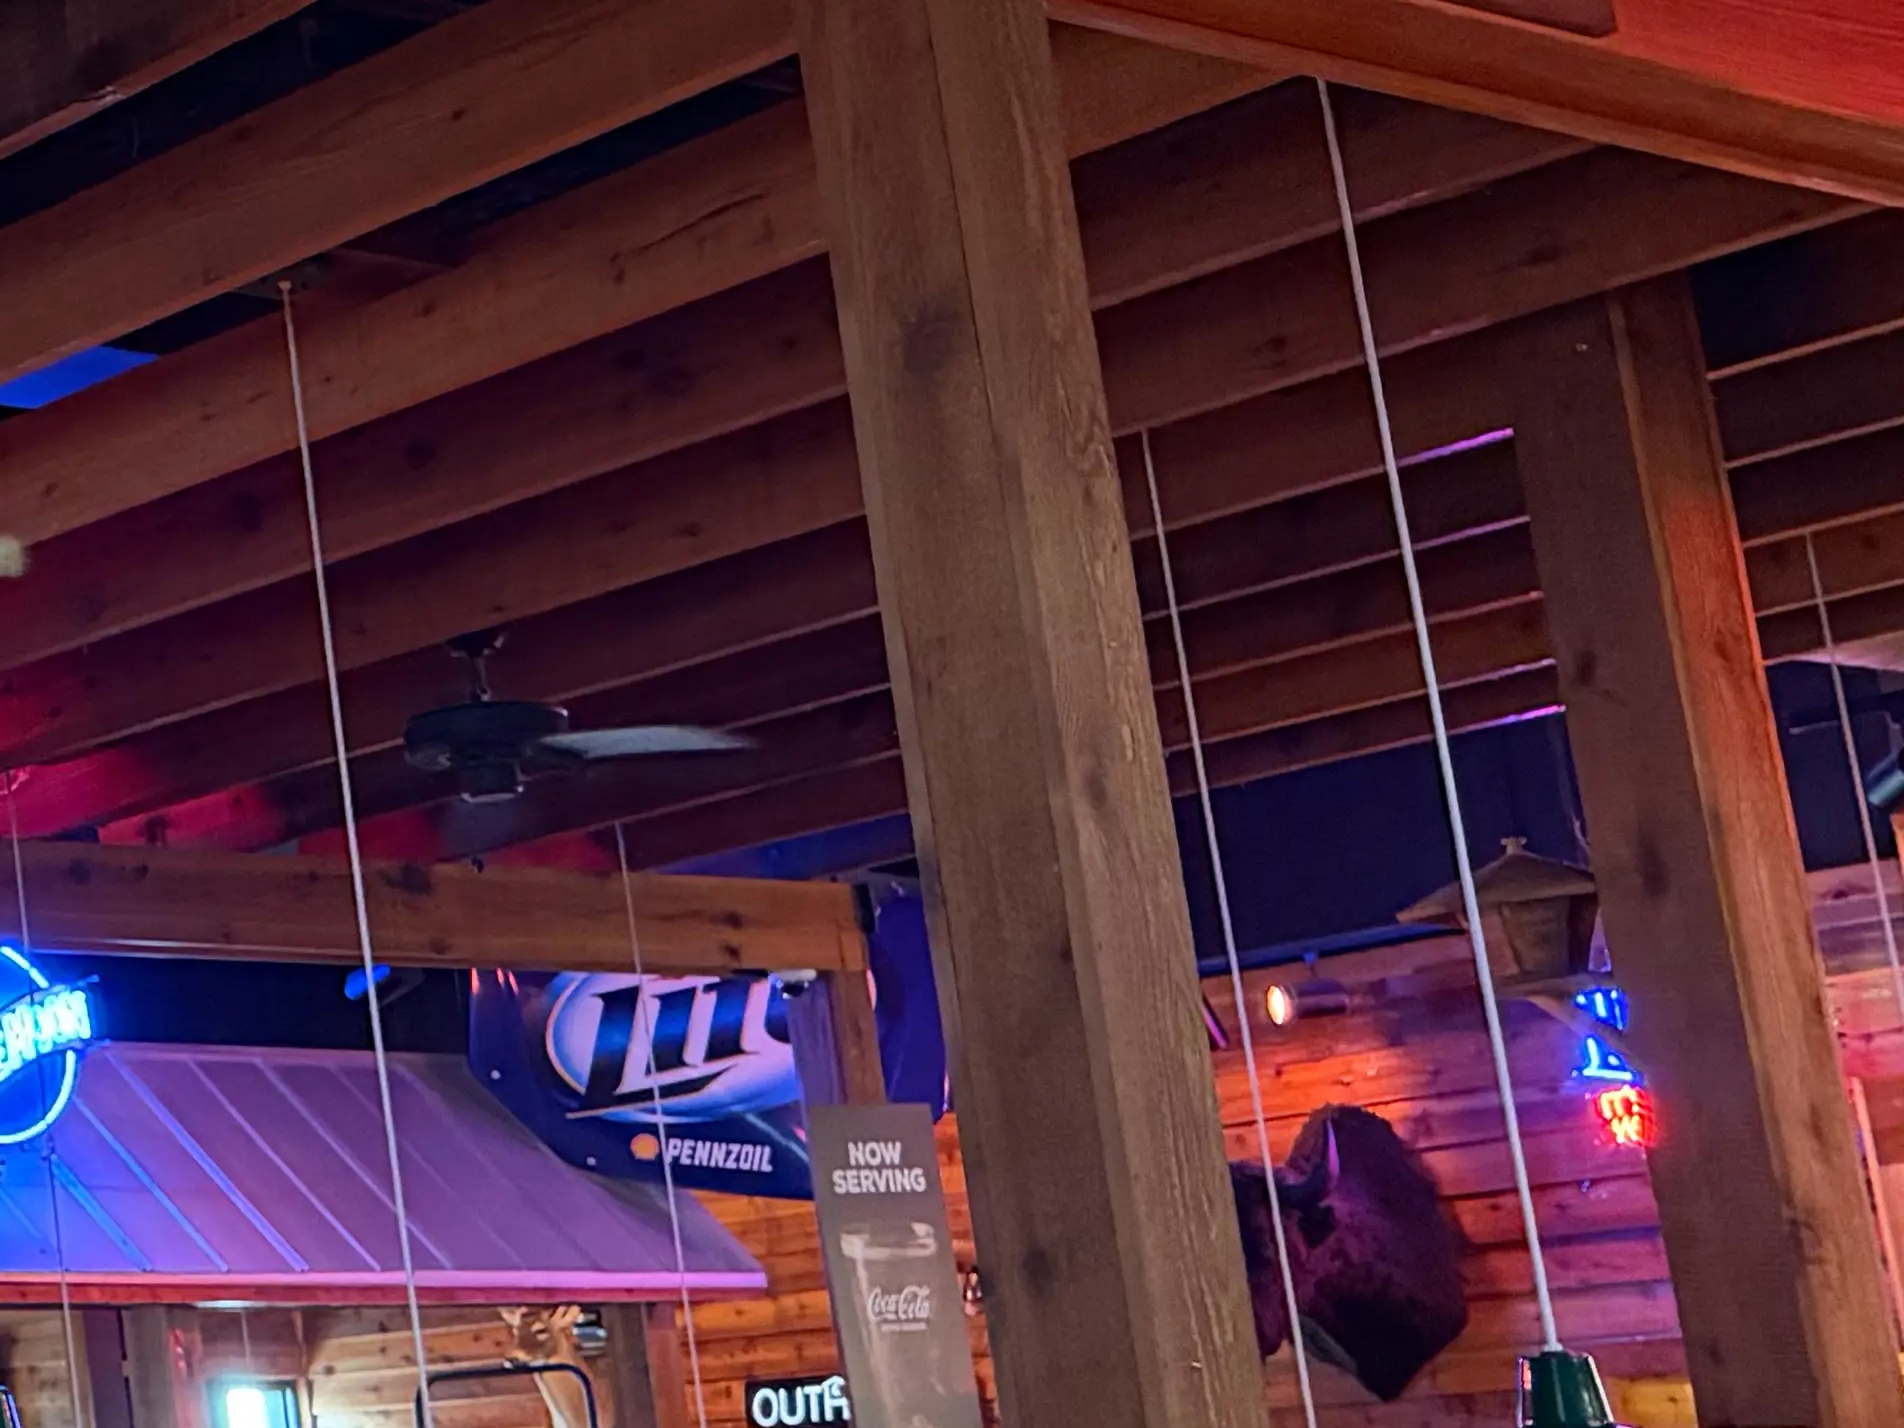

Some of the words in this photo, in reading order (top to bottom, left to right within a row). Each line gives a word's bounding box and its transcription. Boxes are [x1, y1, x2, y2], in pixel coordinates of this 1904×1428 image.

[666, 1137, 774, 1173] PENNZOIL
[847, 1141, 902, 1166] NOW
[832, 1167, 927, 1194] SERVING
